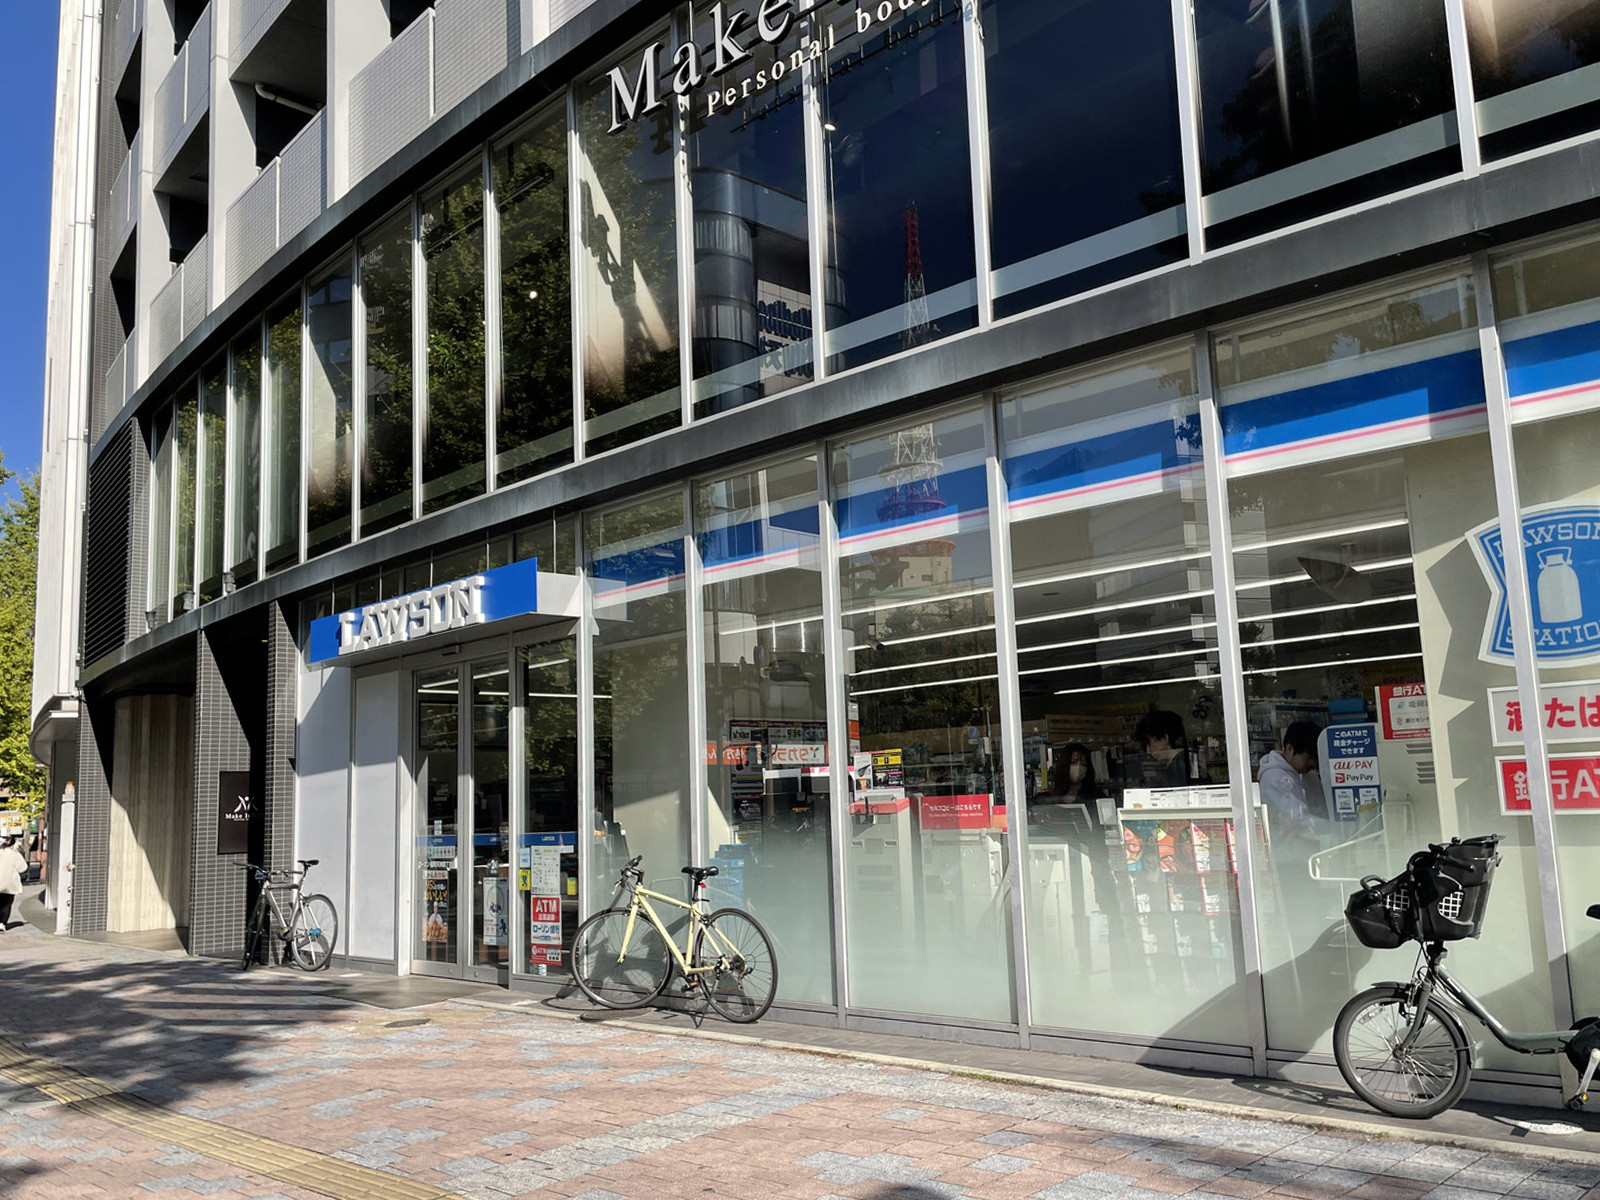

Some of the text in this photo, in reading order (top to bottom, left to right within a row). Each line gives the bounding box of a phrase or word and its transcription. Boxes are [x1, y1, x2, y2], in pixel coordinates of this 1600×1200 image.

[606, 0, 796, 135] Make
[707, 0, 933, 118] Personal bo
[338, 575, 485, 656] LAWSON
[1333, 760, 1373, 770] au PAY
[1346, 774, 1374, 782] PayPay
[1513, 768, 1600, 801] 銀行A
[535, 899, 557, 913] ATM
